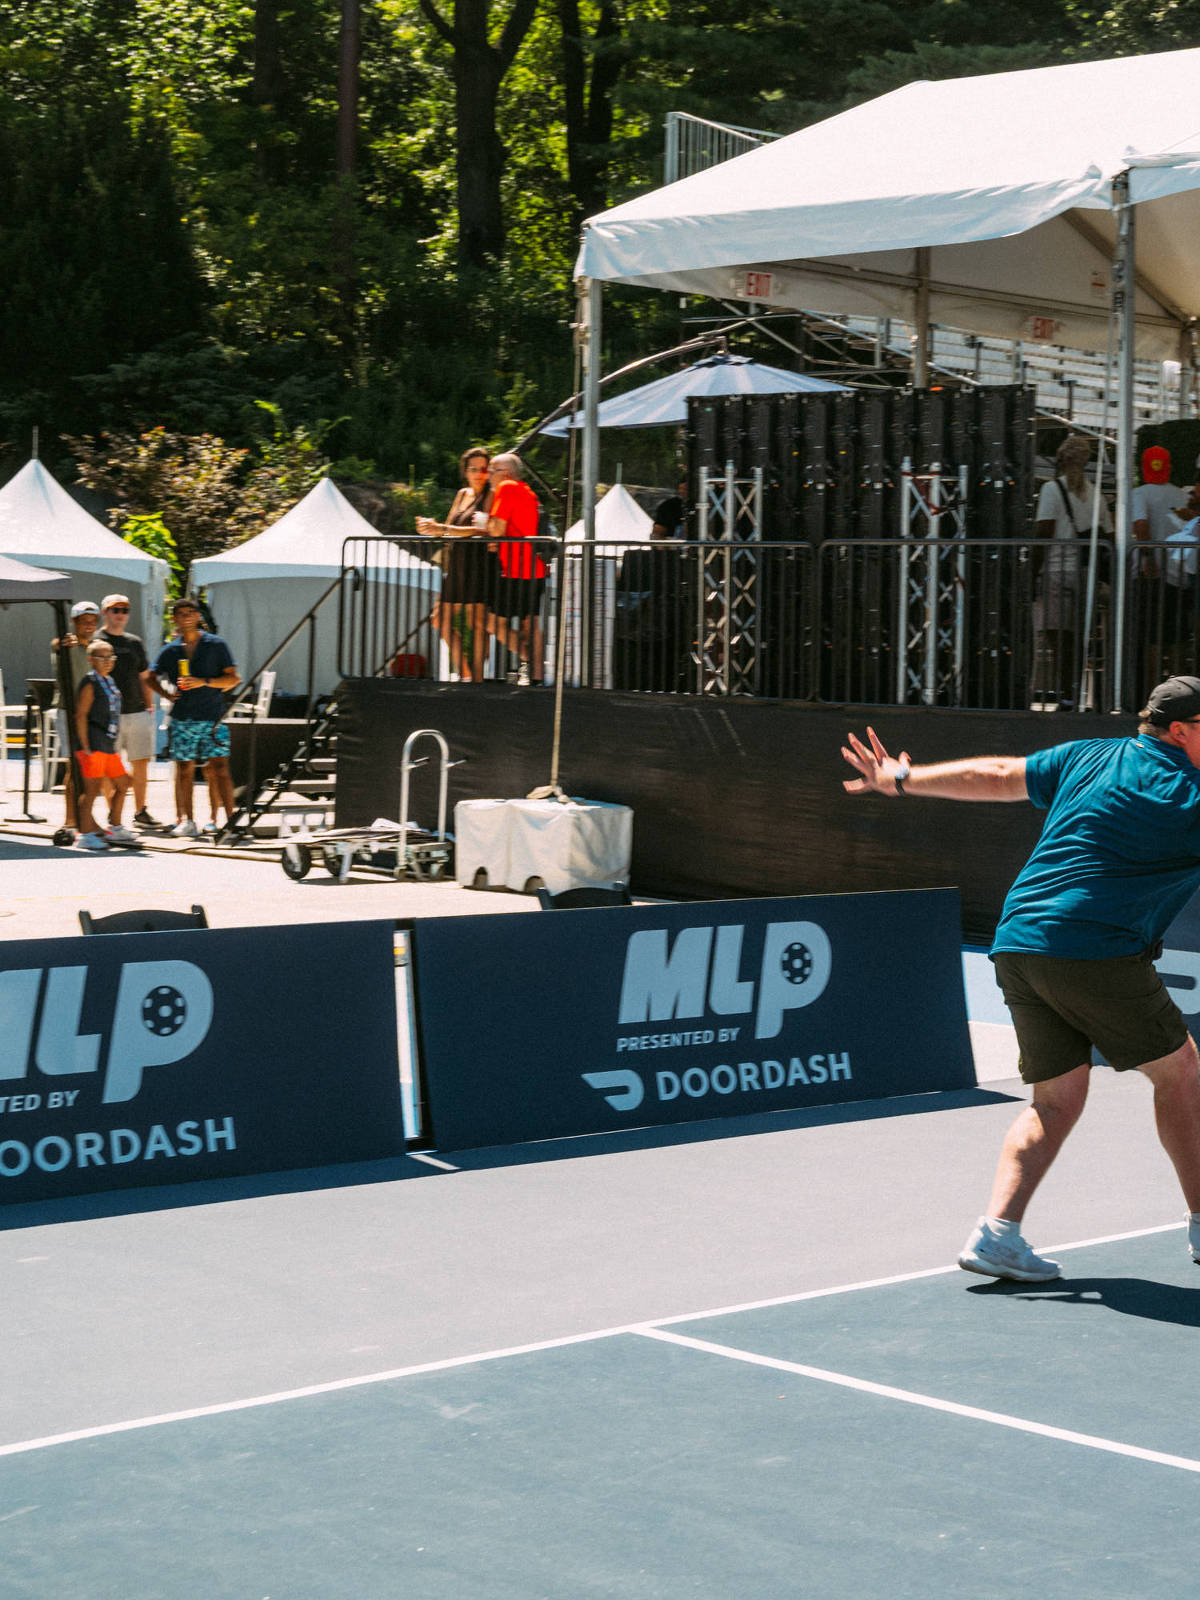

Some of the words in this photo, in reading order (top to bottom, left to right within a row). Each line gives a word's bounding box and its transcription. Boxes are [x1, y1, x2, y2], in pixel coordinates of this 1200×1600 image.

[618, 921, 832, 1040] MLP
[616, 1029, 714, 1052] PRESENTED
[718, 1027, 740, 1042] BY
[656, 1052, 852, 1101] DOORDASH
[47, 1089, 80, 1109] BY
